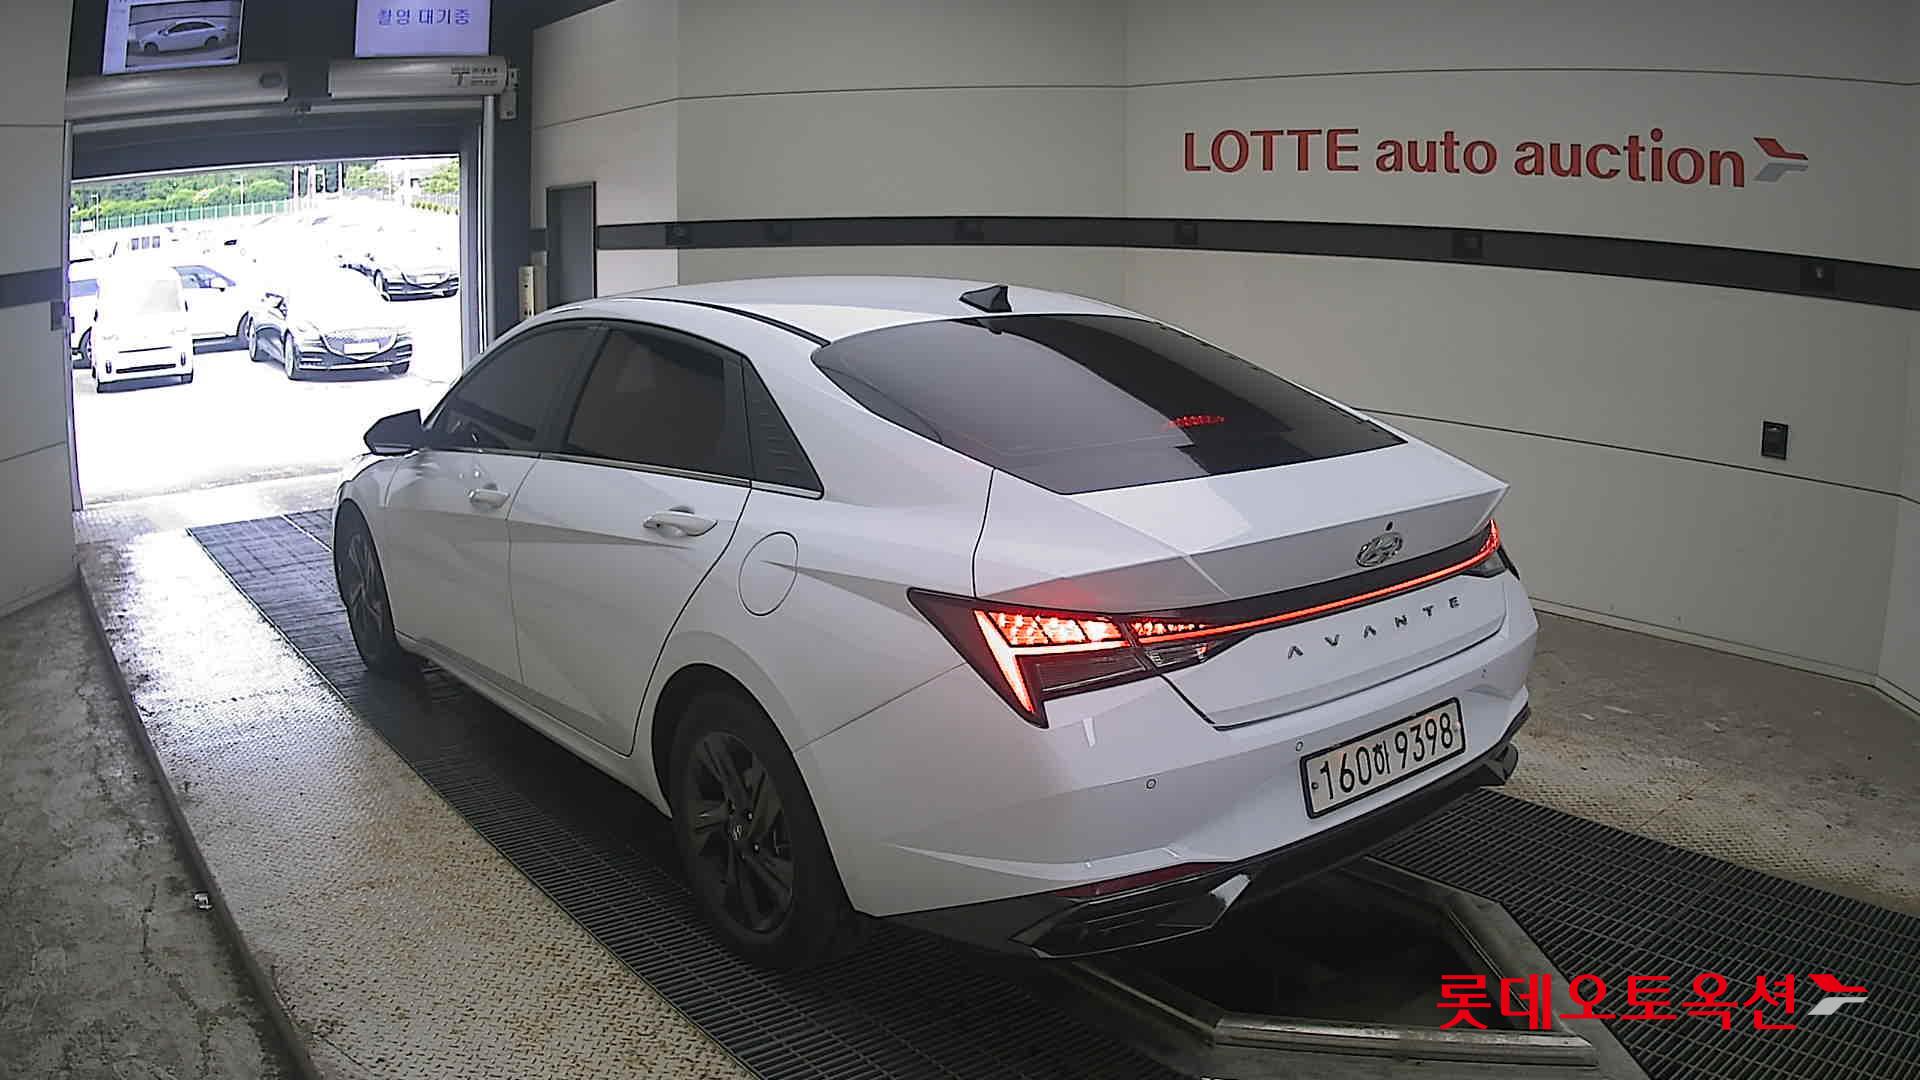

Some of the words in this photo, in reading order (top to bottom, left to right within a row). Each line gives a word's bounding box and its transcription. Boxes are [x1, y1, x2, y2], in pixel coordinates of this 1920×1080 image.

[418, 8, 471, 25] 대기중
[1184, 128, 1359, 172] LOTTE
[1375, 130, 1498, 175] auto
[1514, 128, 1745, 187] auction
[1288, 596, 1460, 660] AVANTE
